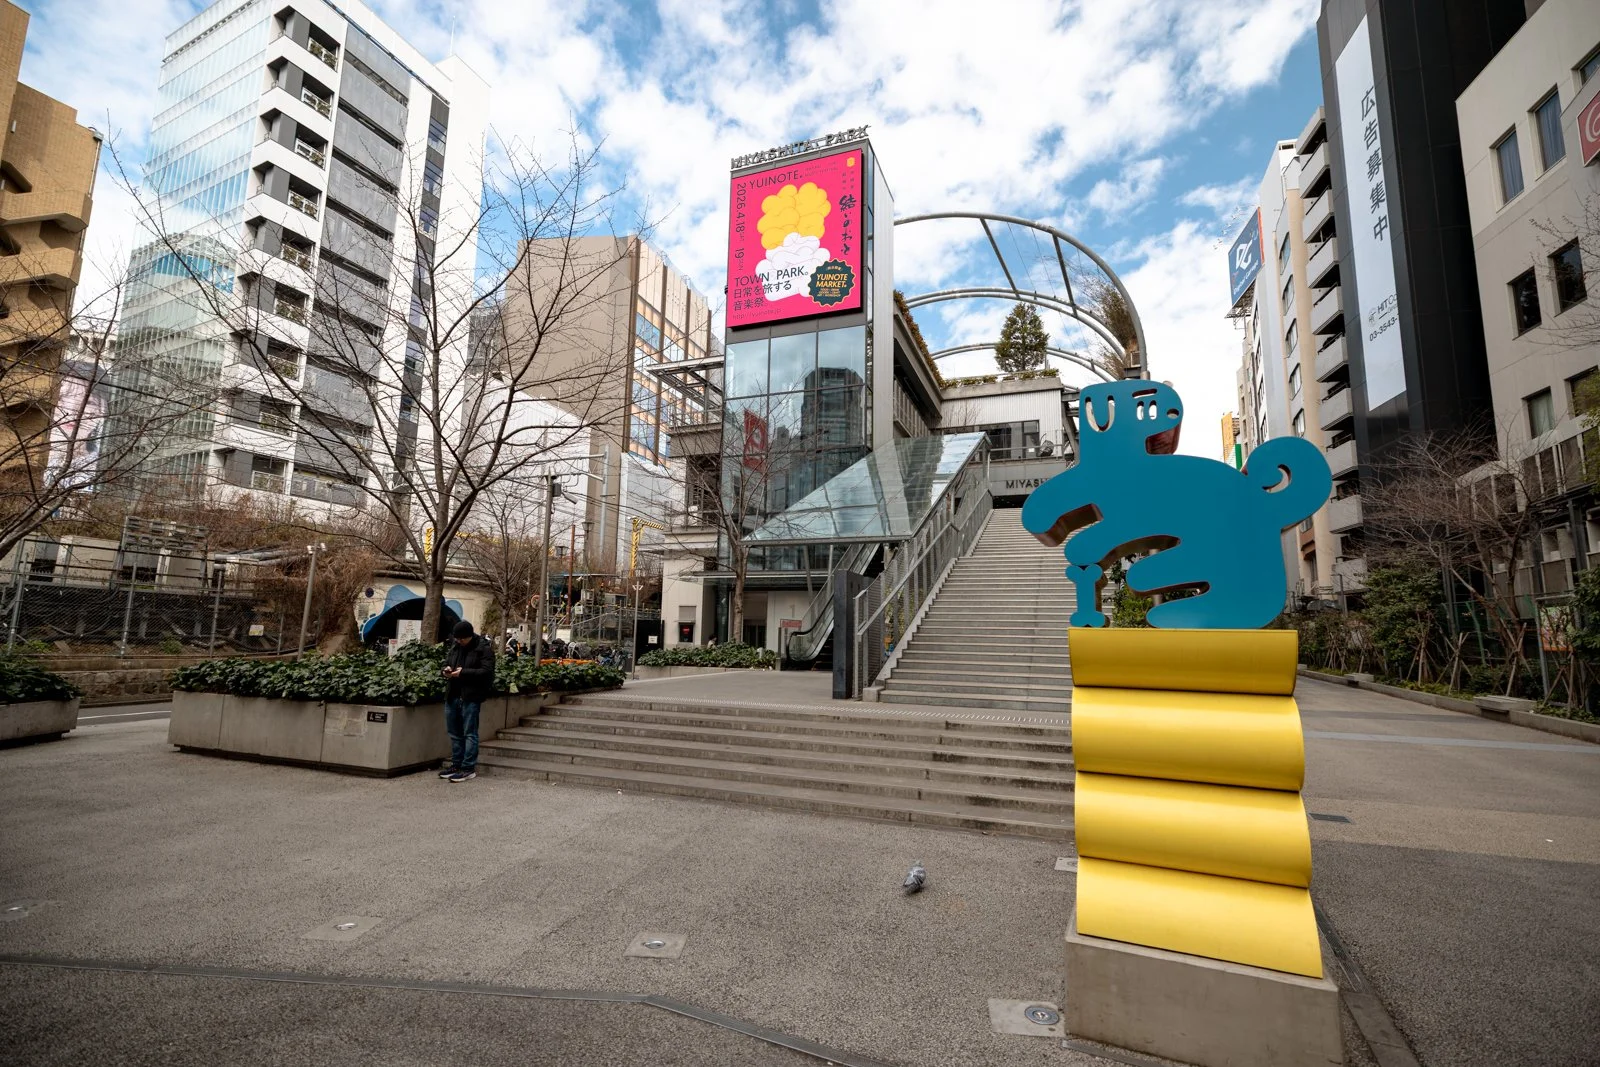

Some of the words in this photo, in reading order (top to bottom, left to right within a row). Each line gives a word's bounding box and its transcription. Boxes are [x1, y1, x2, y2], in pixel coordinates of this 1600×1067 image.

[731, 141, 816, 169] MIYASHITA
[826, 124, 870, 146] PARK
[1361, 86, 1388, 241] 広告募集中
[735, 248, 744, 259] 19
[735, 272, 770, 287] TOWN
[816, 273, 848, 281] YUINOTE
[734, 280, 792, 299] 日常を旅する
